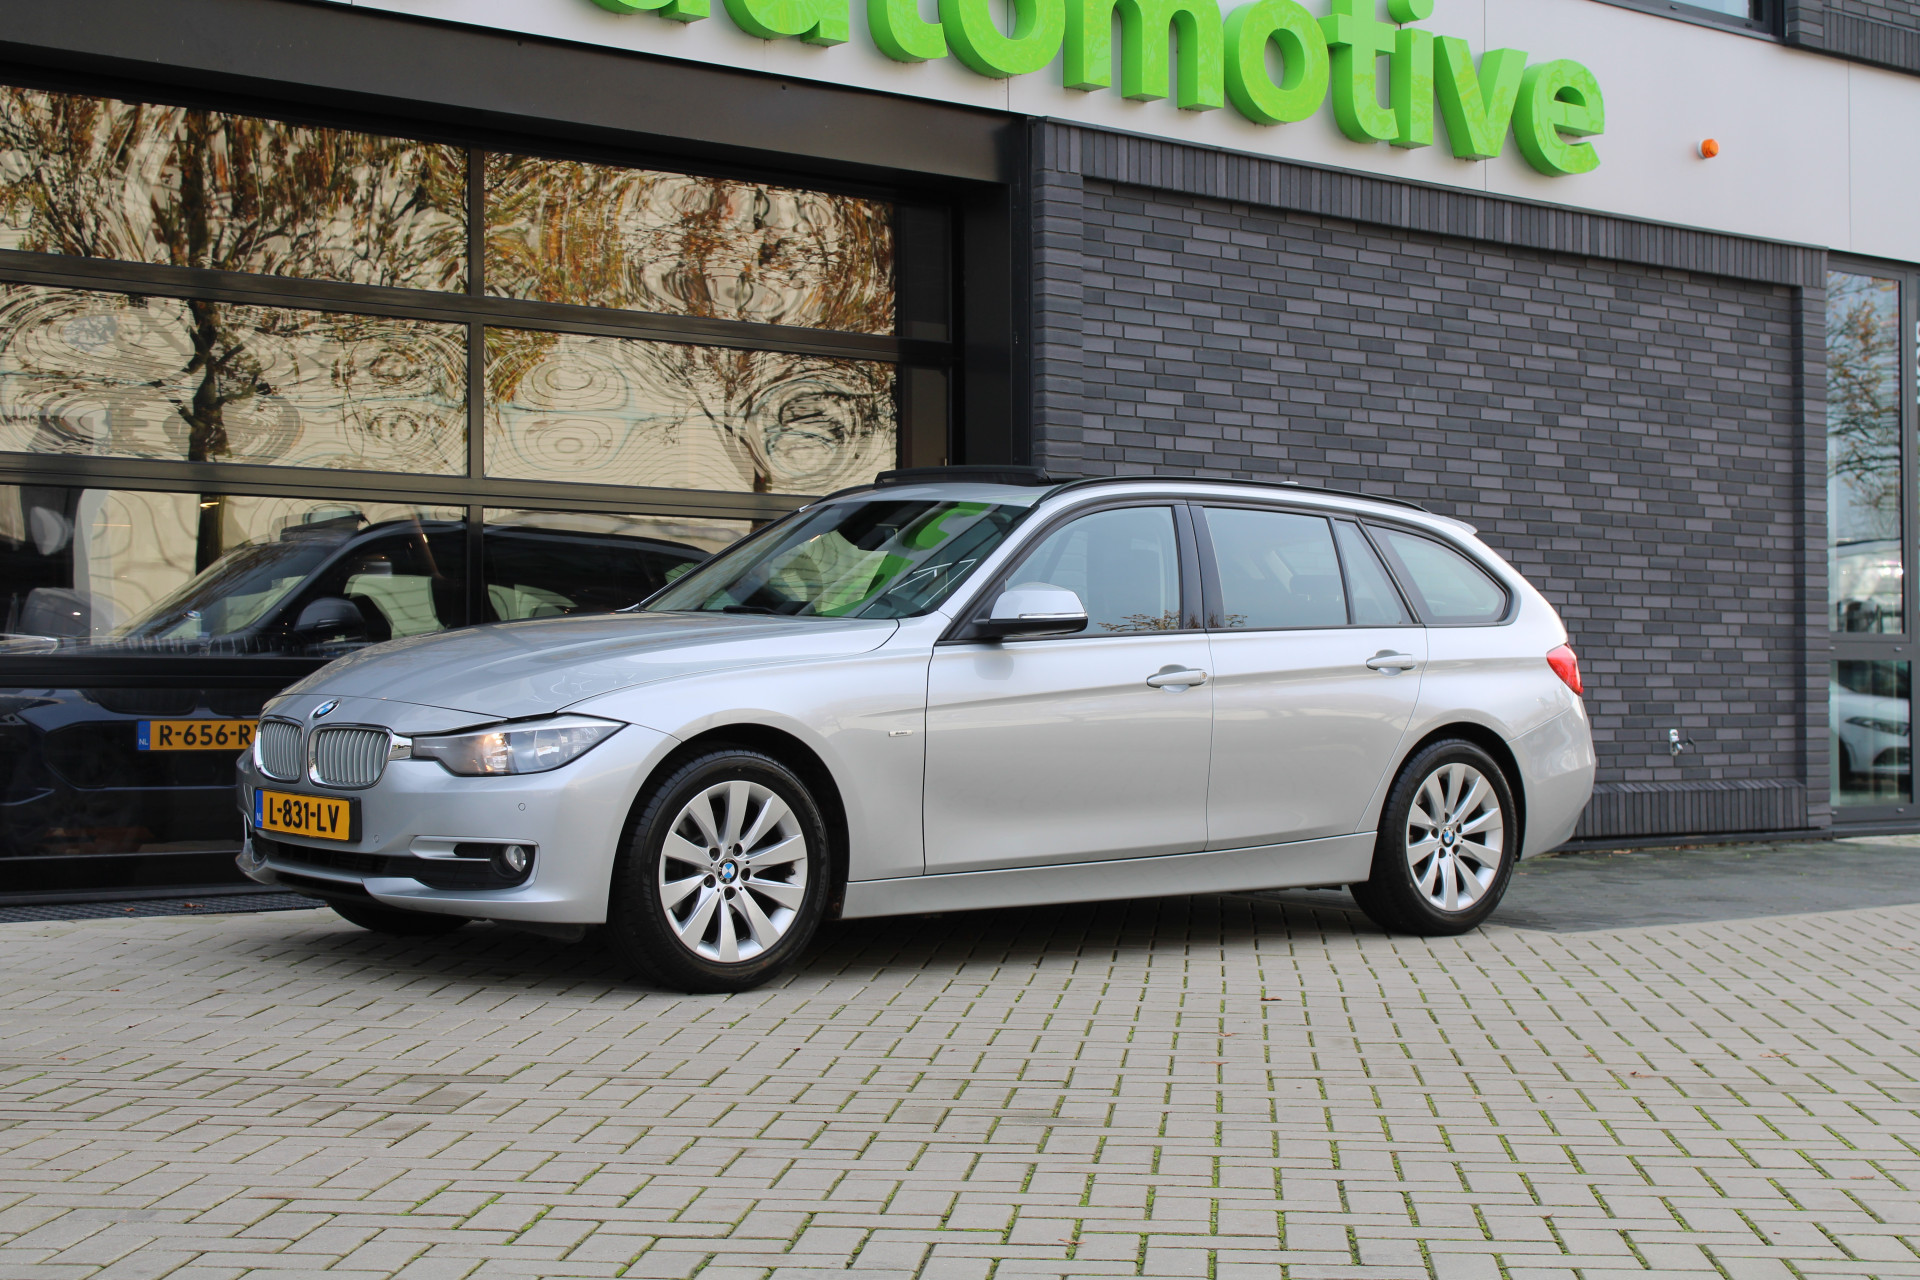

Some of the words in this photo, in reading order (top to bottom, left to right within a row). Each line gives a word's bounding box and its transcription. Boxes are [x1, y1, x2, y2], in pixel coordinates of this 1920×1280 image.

[588, 0, 1605, 177] omotive
[138, 738, 149, 746] NL
[159, 724, 258, 746] R-656-R
[269, 797, 340, 833] L-831-LV
